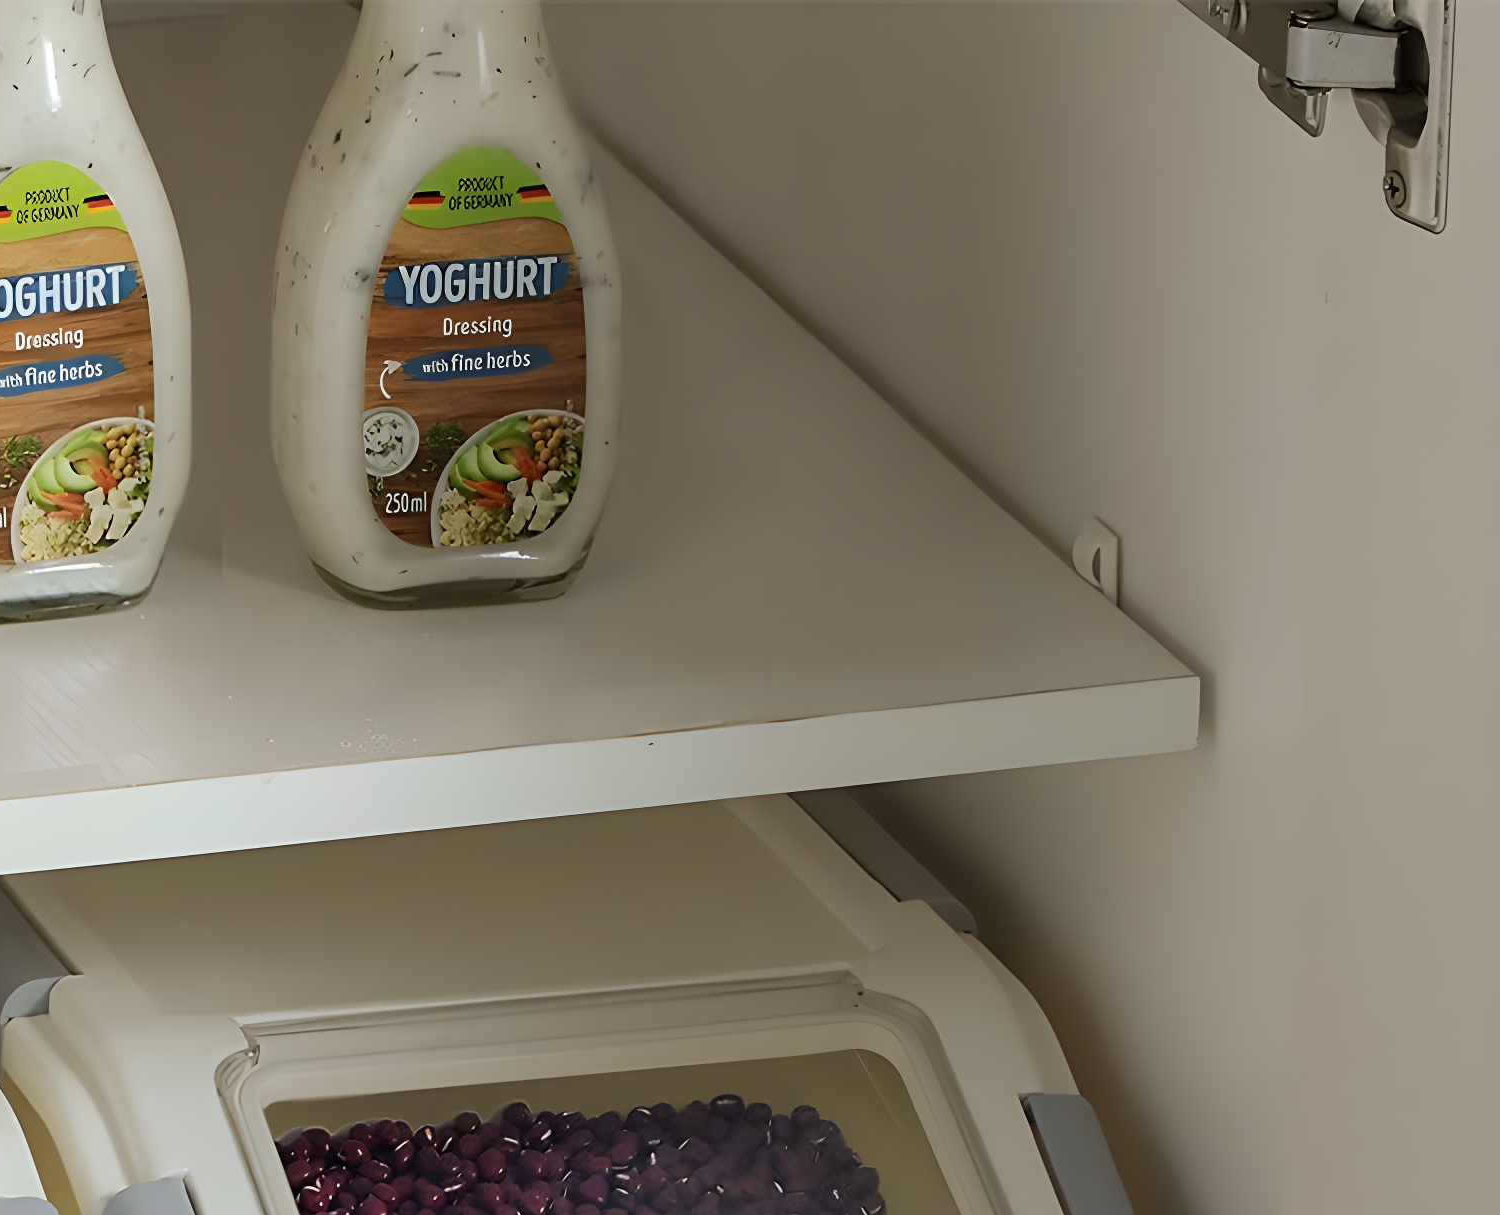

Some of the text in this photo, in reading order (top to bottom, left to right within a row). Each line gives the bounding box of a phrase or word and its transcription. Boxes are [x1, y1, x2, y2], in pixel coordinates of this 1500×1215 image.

[448, 194, 462, 211] OF
[16, 209, 29, 225] OF
[398, 255, 559, 306] YOGHURT
[14, 326, 84, 351] Dressing
[442, 315, 513, 338] Dressing
[24, 364, 56, 387] fine
[58, 359, 103, 382] herbs
[422, 349, 531, 374] with fine herbs
